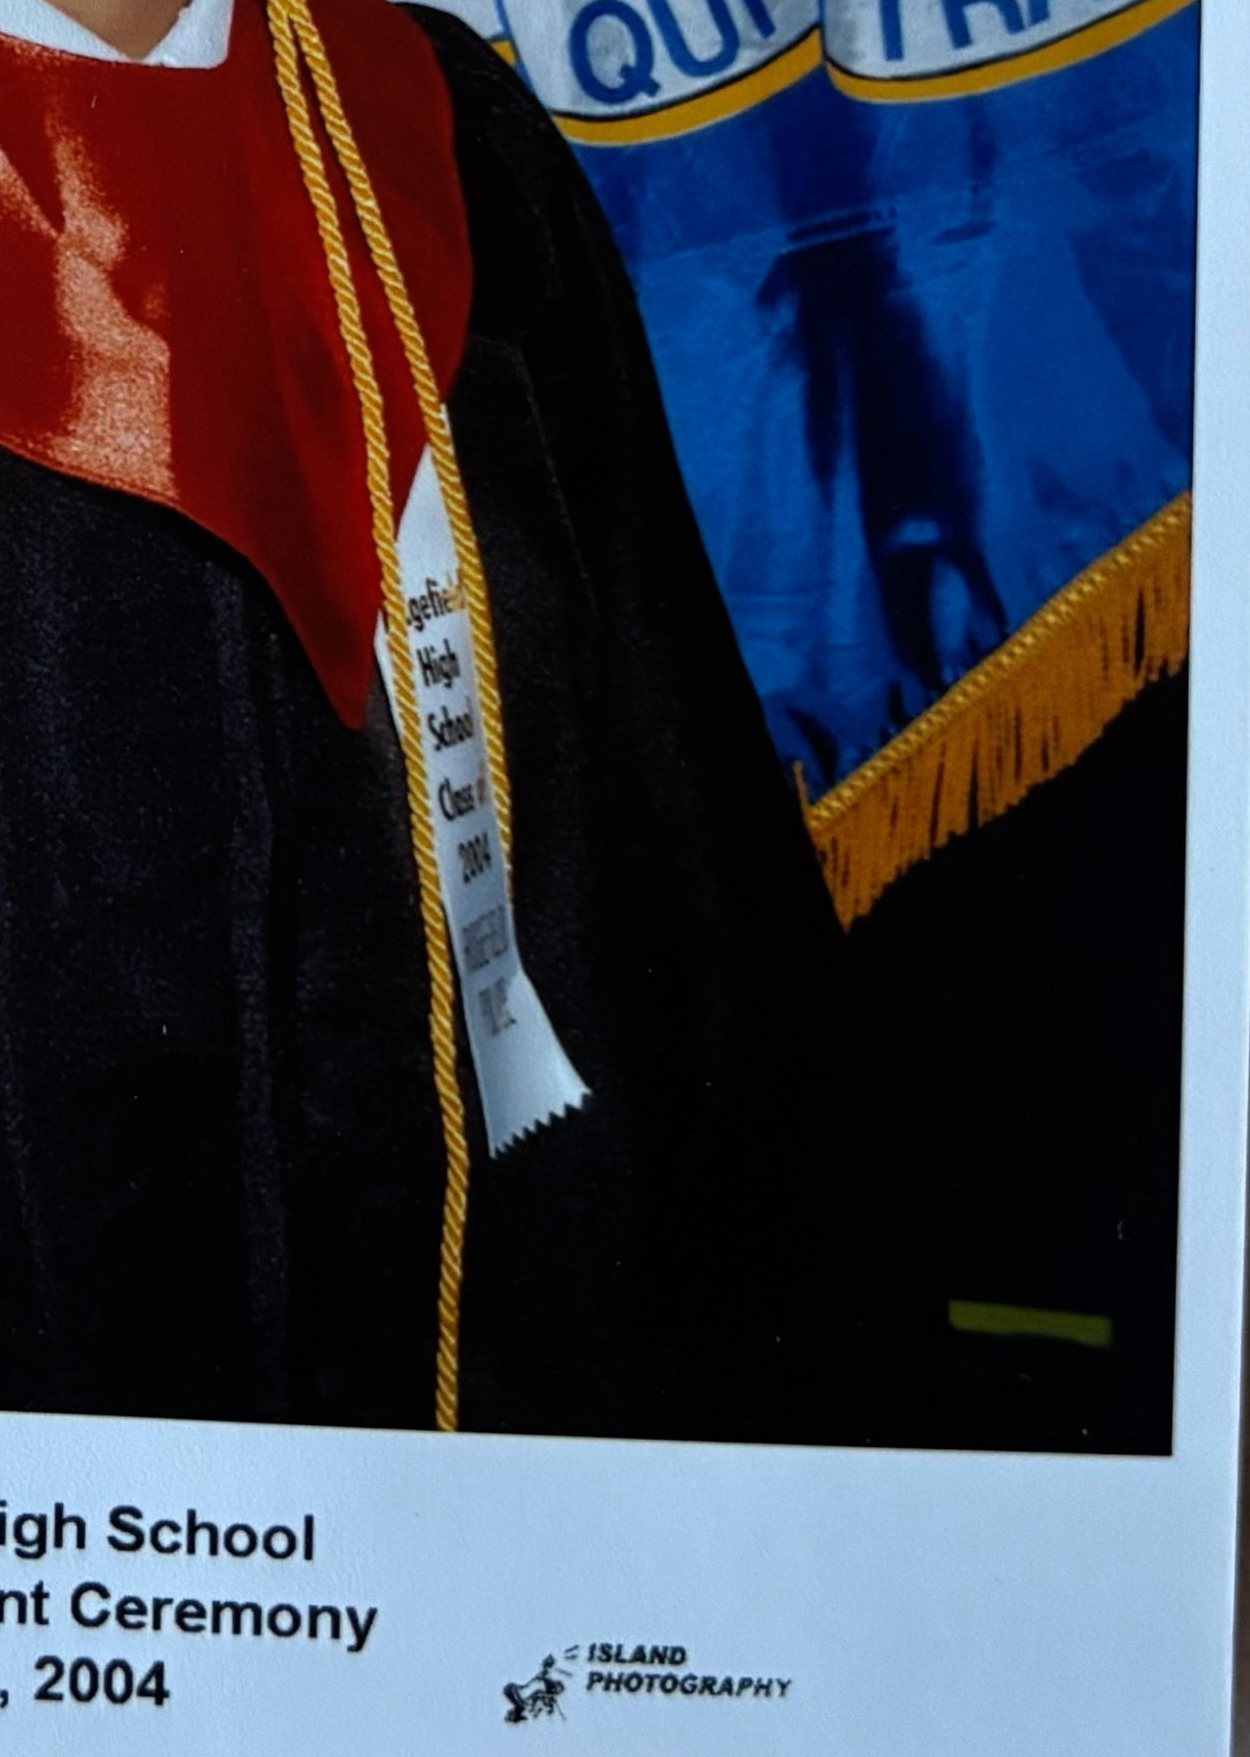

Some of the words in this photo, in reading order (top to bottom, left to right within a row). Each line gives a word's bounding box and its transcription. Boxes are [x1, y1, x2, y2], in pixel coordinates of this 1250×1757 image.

[416, 637, 460, 689] High
[427, 697, 474, 752] School
[437, 776, 475, 822] Class
[458, 832, 492, 884] 2004
[107, 1505, 314, 1562] School
[70, 1581, 378, 1653] Ceremony
[587, 1642, 687, 1667] ISLAND
[34, 1655, 171, 1707] 2004
[585, 1671, 792, 1698] PHOTOGRAPHY
